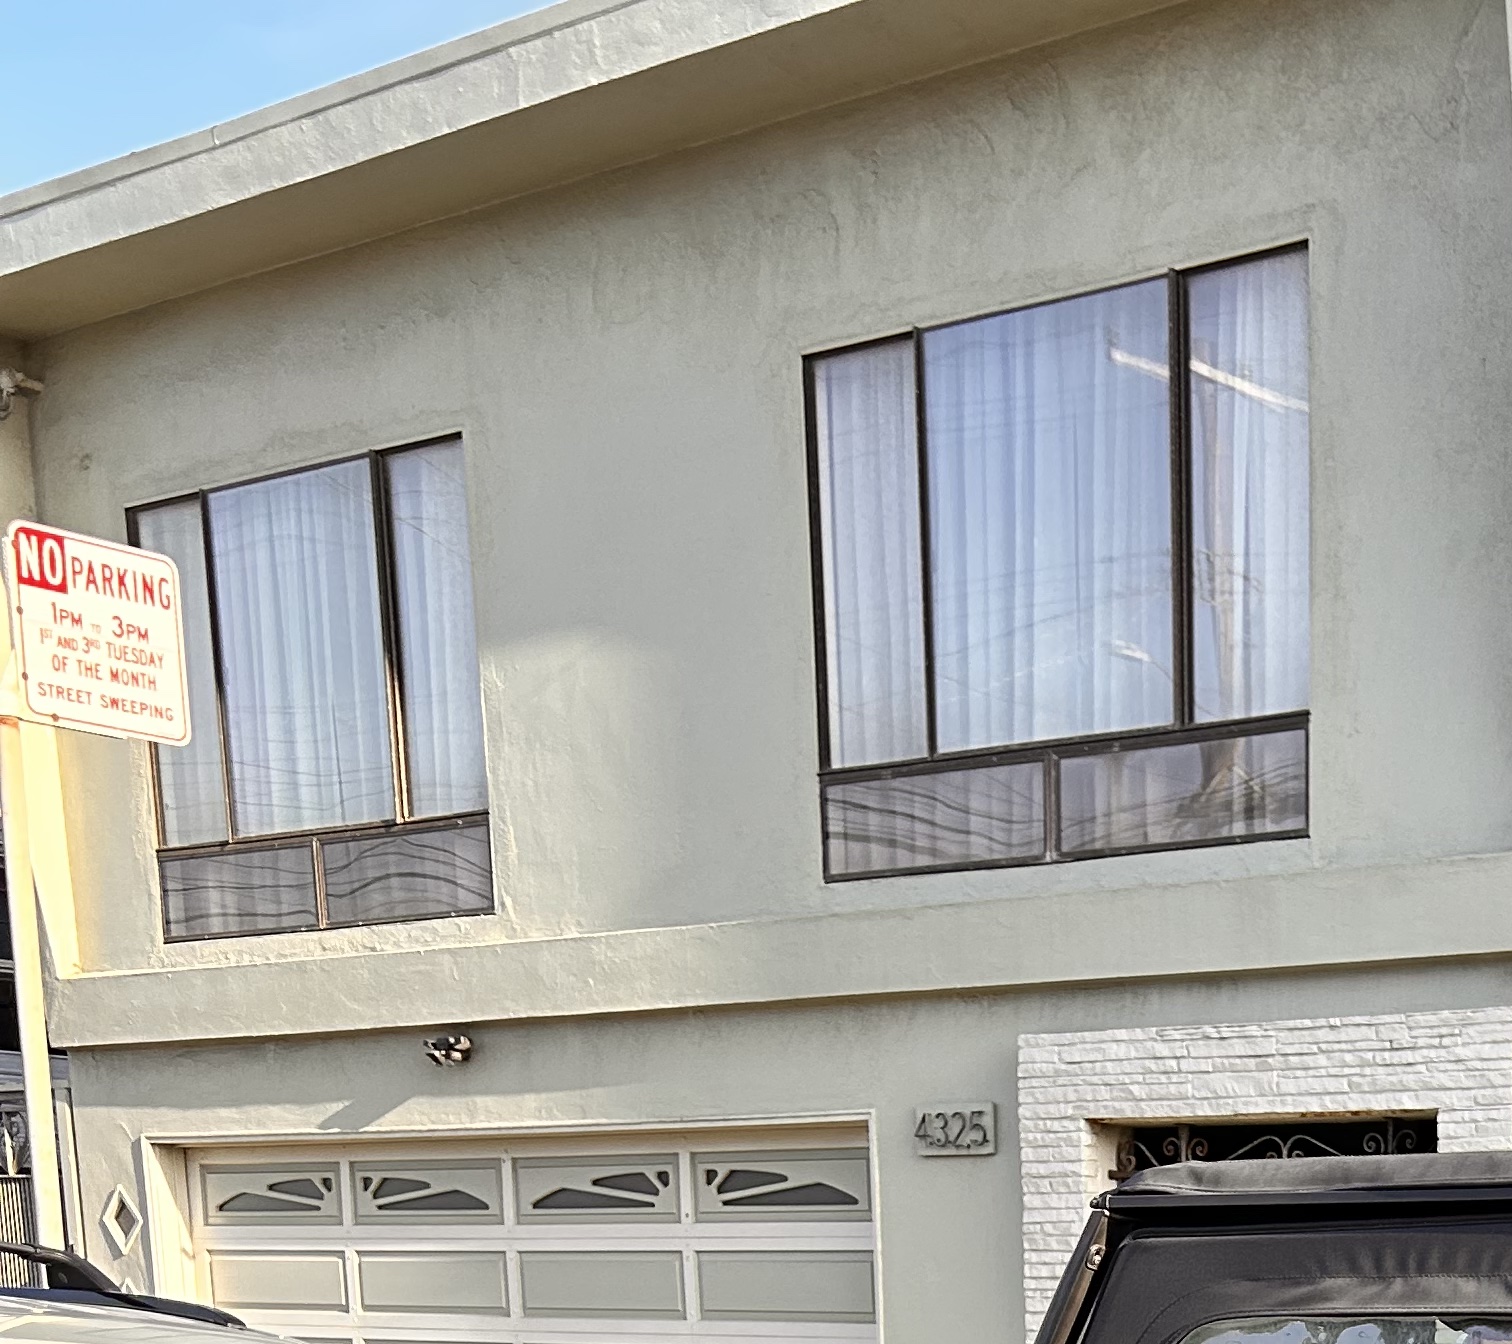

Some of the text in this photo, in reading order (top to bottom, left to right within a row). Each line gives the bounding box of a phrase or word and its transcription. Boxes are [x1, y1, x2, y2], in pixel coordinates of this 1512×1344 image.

[18, 531, 171, 610] NO PARKING
[51, 601, 149, 644] 1PM TO 3PM
[40, 627, 164, 670] 1ST AND 3RD TUESDAY
[51, 654, 157, 692] OF THE MONTH
[37, 681, 174, 722] STREET SWEEPING
[914, 1109, 990, 1149] 4325
